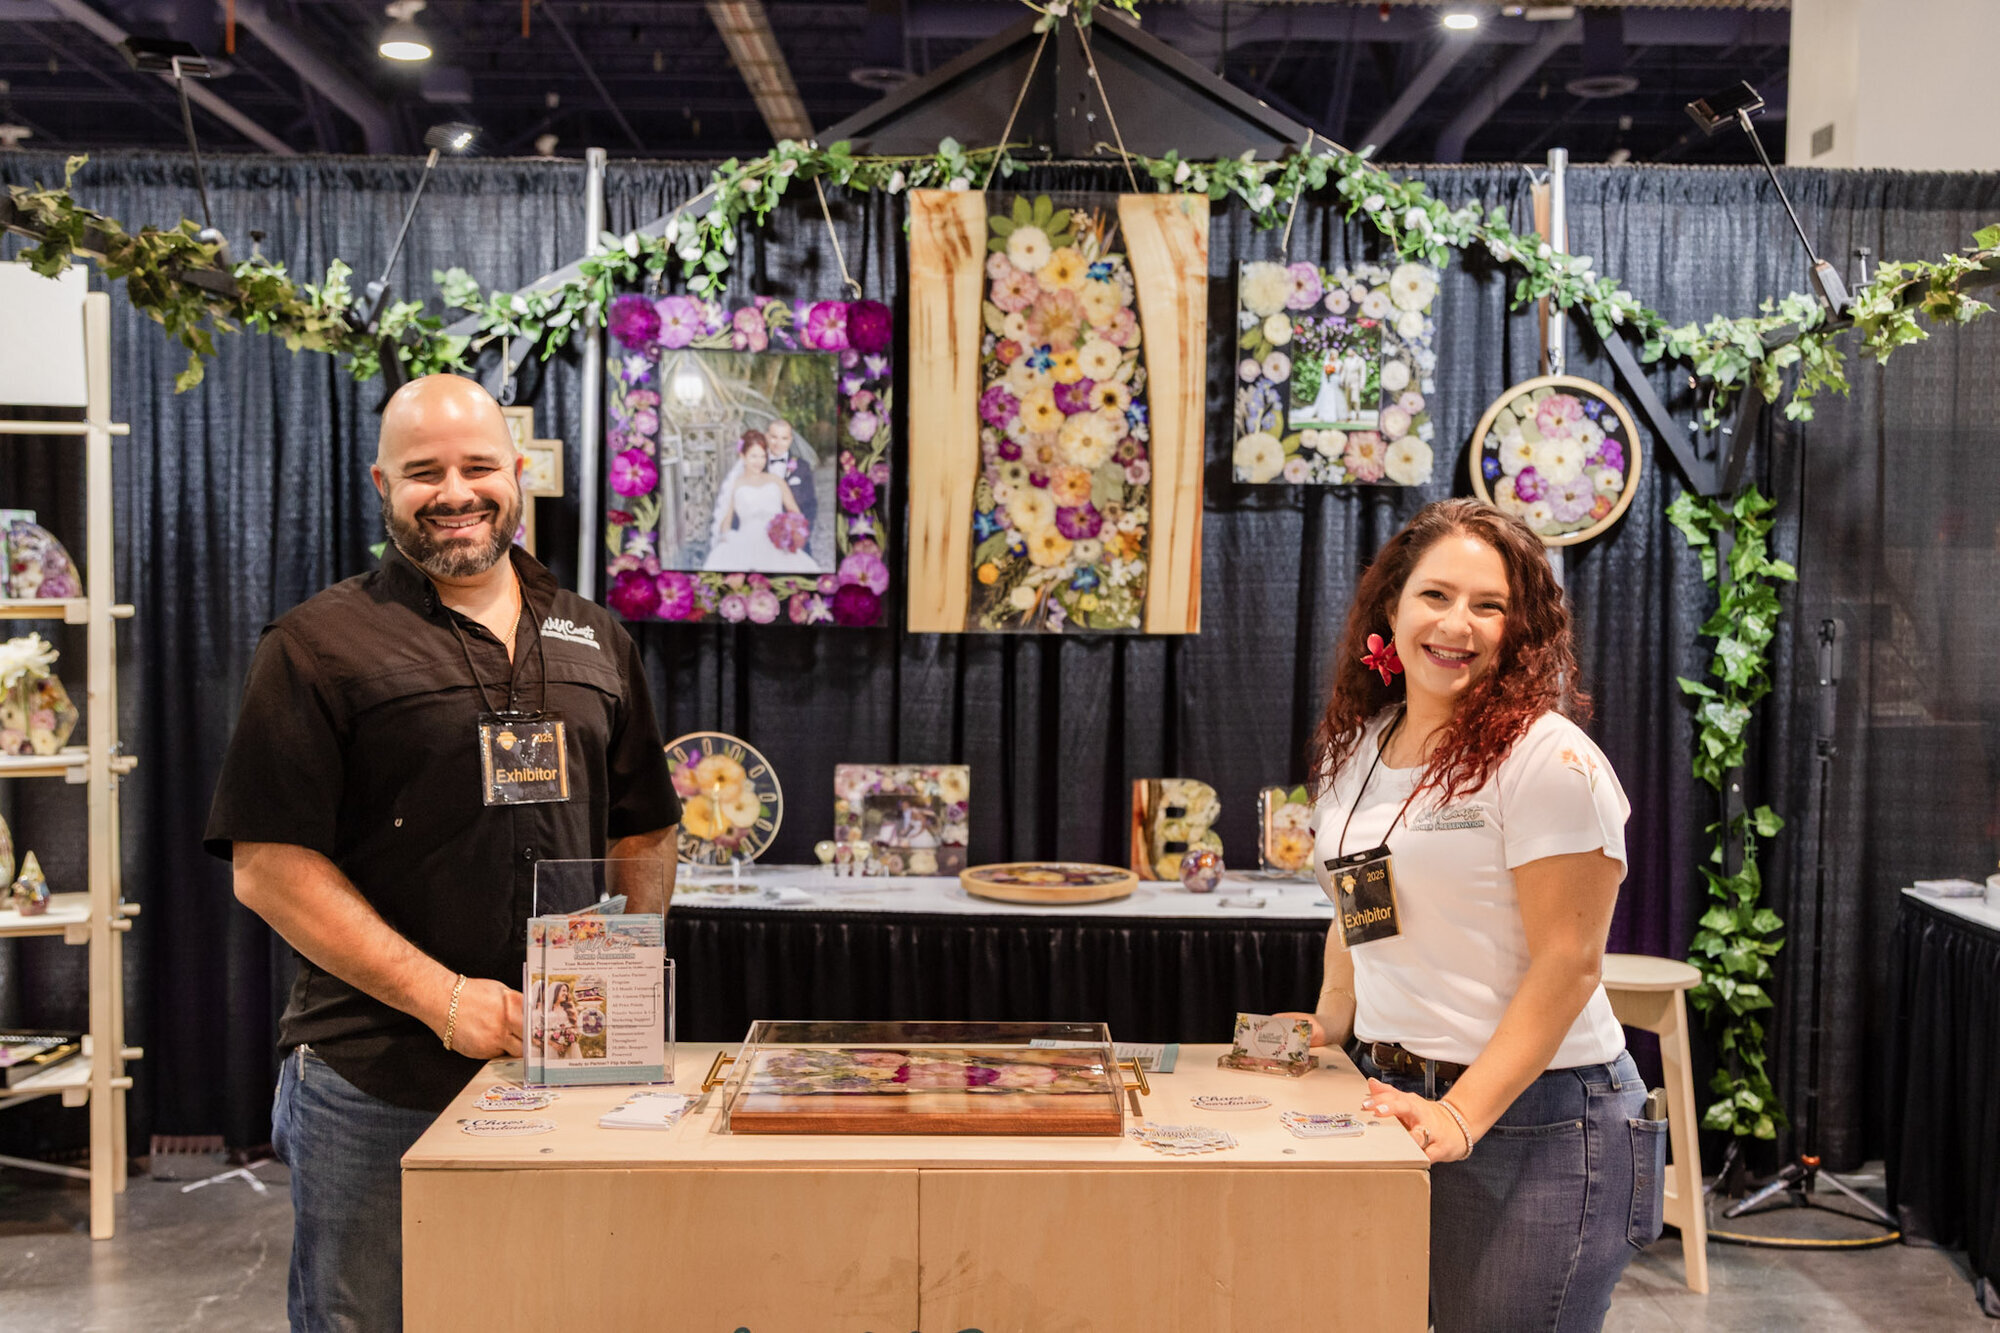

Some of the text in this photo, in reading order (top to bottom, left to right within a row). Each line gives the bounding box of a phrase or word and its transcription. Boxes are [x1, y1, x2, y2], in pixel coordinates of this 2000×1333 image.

[531, 733, 554, 743] 2025
[495, 768, 558, 783] Exhibitor
[1367, 869, 1385, 883] 2025
[1344, 906, 1392, 929] Exhibitor
